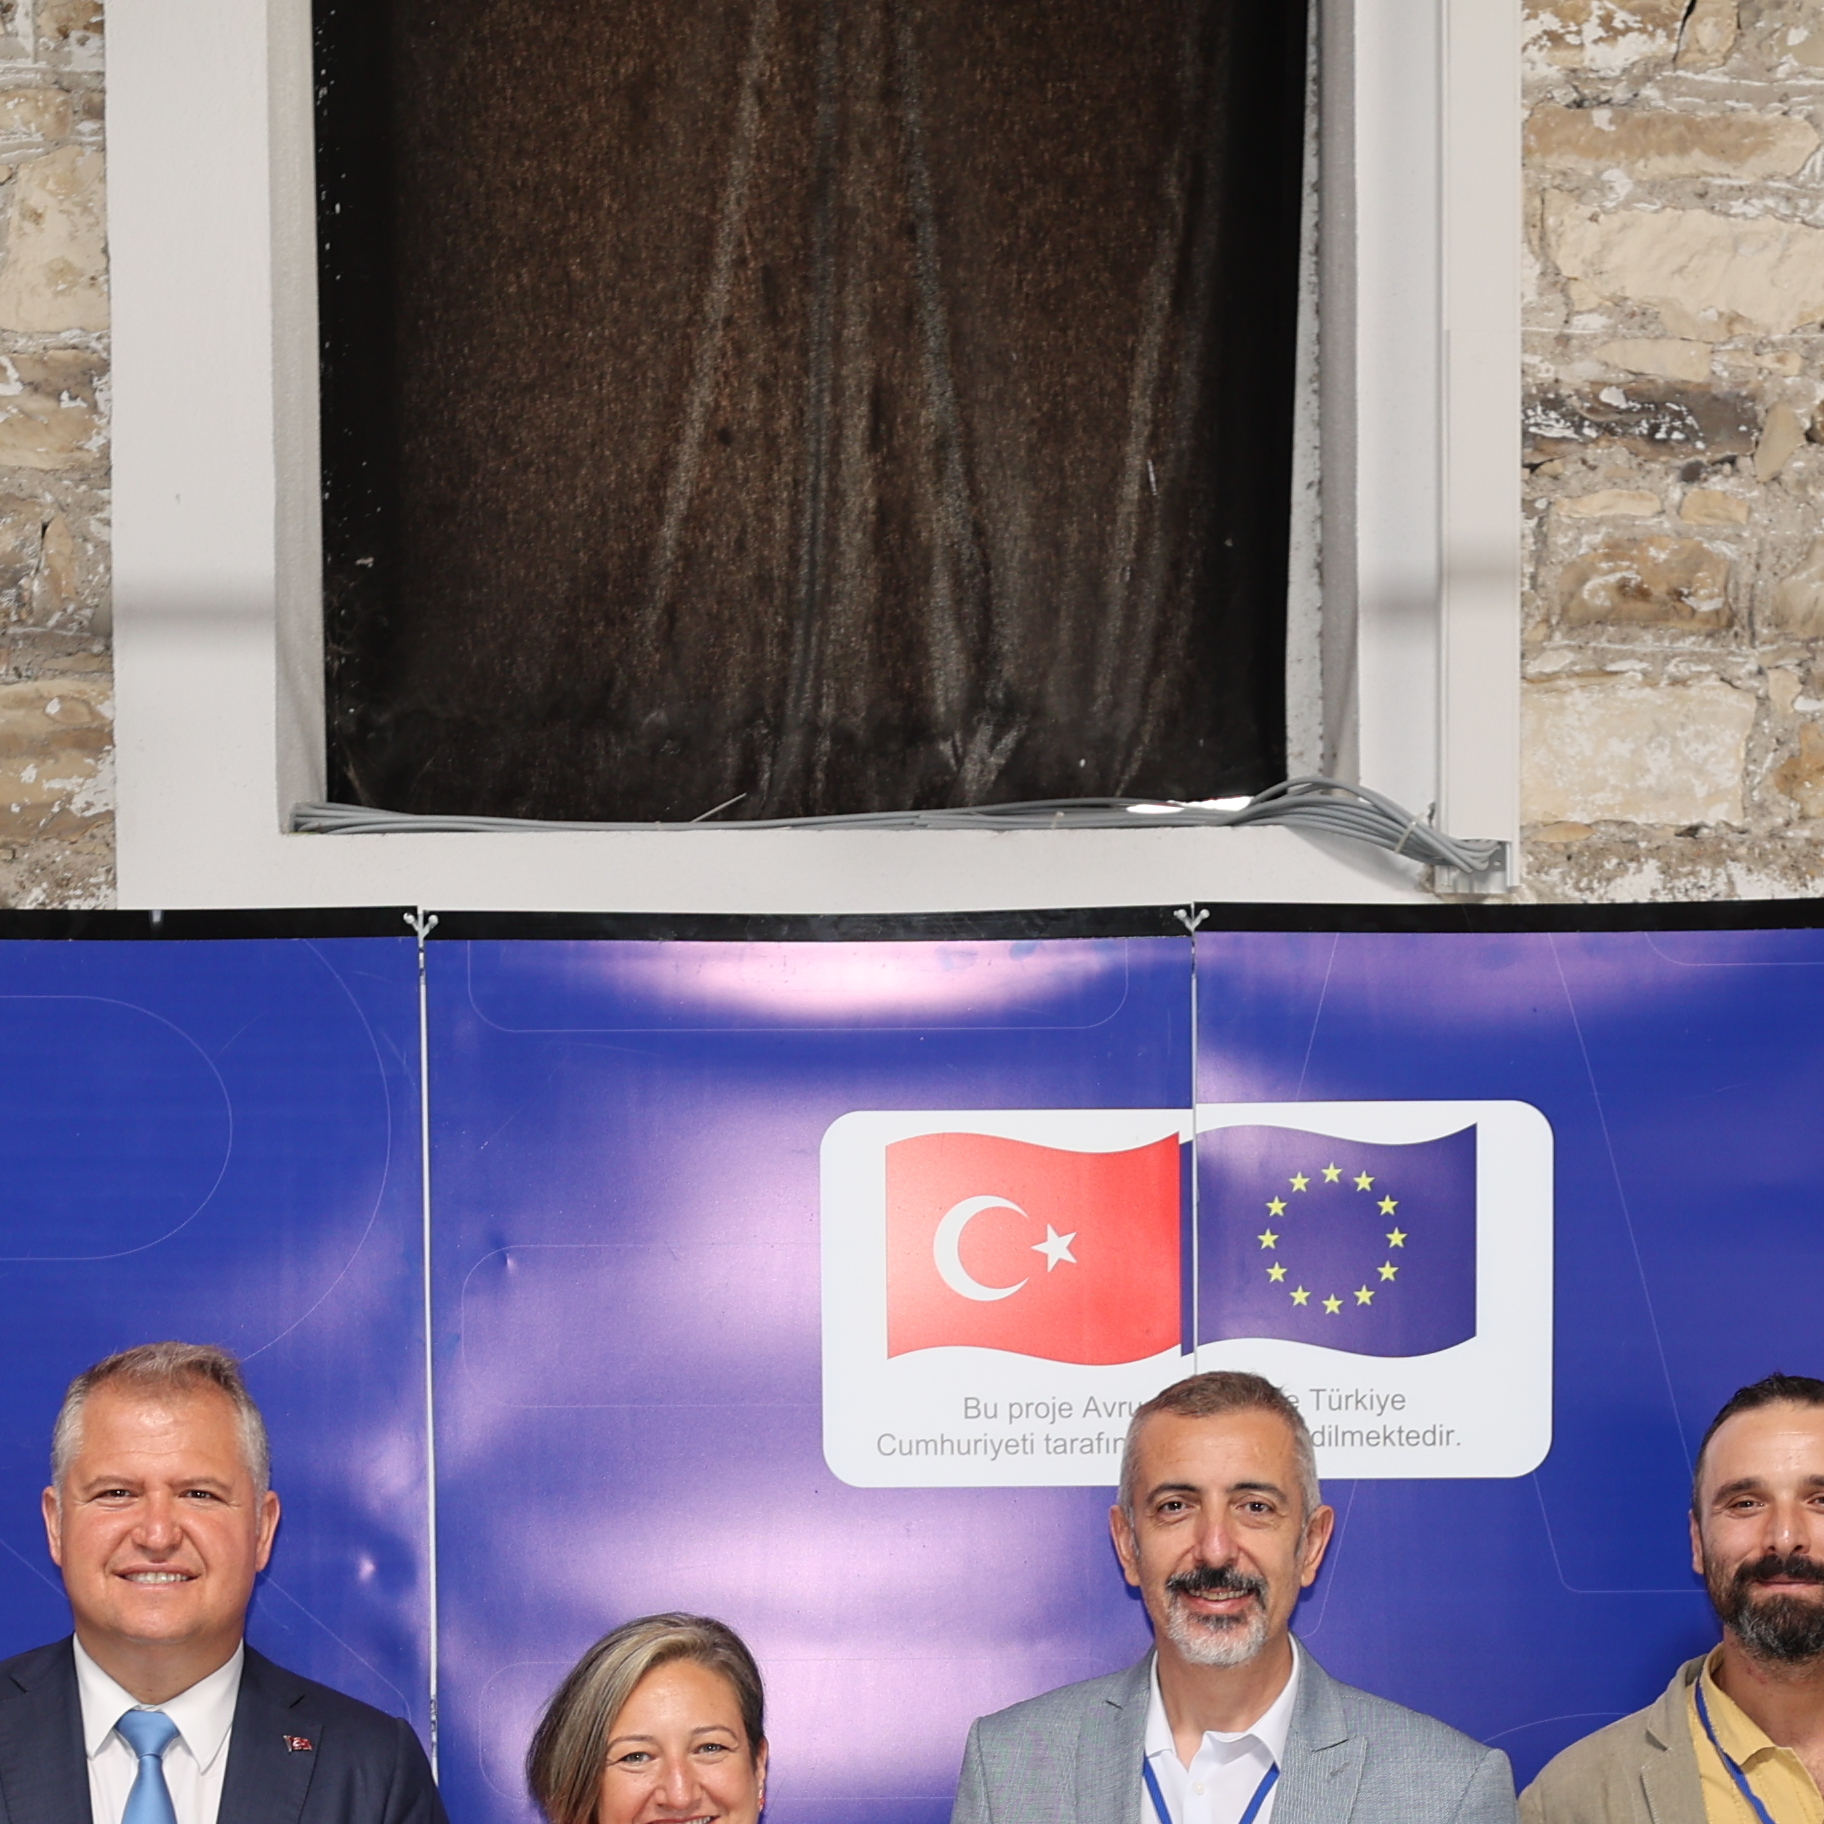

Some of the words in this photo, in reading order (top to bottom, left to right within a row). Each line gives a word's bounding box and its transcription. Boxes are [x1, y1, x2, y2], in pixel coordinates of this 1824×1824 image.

[963, 1396, 998, 1419] Bu
[1008, 1396, 1073, 1425] proje
[1309, 1388, 1406, 1417] Türkiye
[877, 1433, 1034, 1462] Cumhuriyeti
